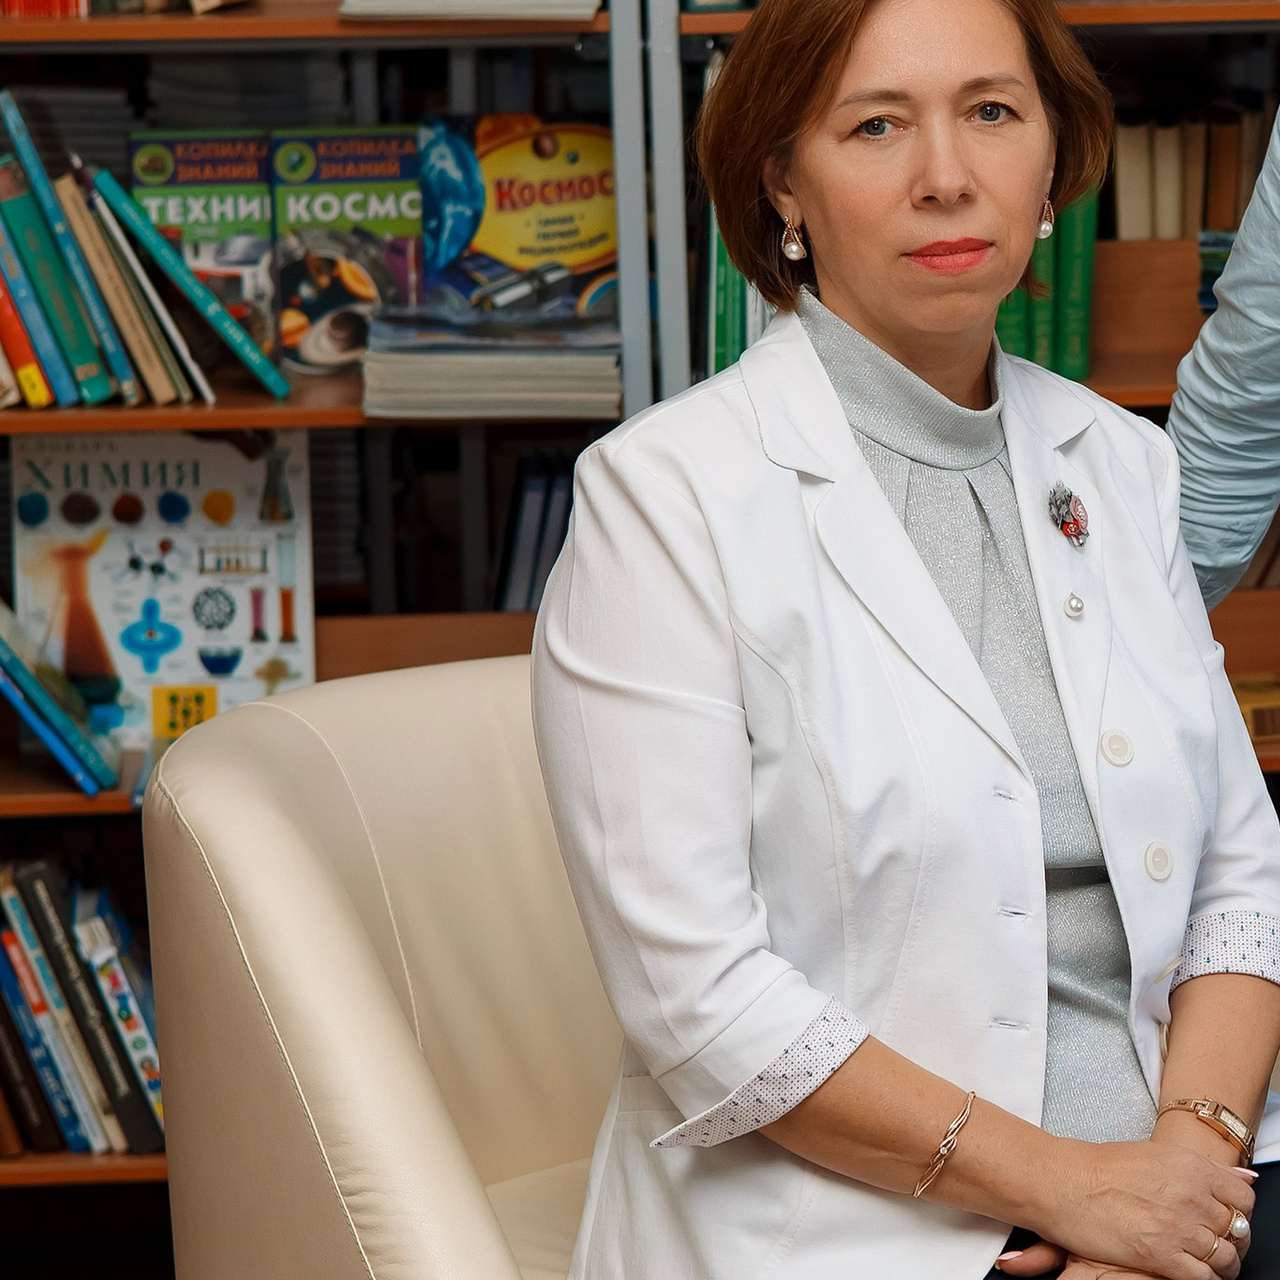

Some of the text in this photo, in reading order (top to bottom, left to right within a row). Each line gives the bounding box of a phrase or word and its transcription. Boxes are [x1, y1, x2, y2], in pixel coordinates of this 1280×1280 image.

[175, 159, 259, 181] ЗНАНИЙ
[319, 160, 401, 181] ЗНАНИЙ
[24, 457, 201, 491] ХИМИЯ
